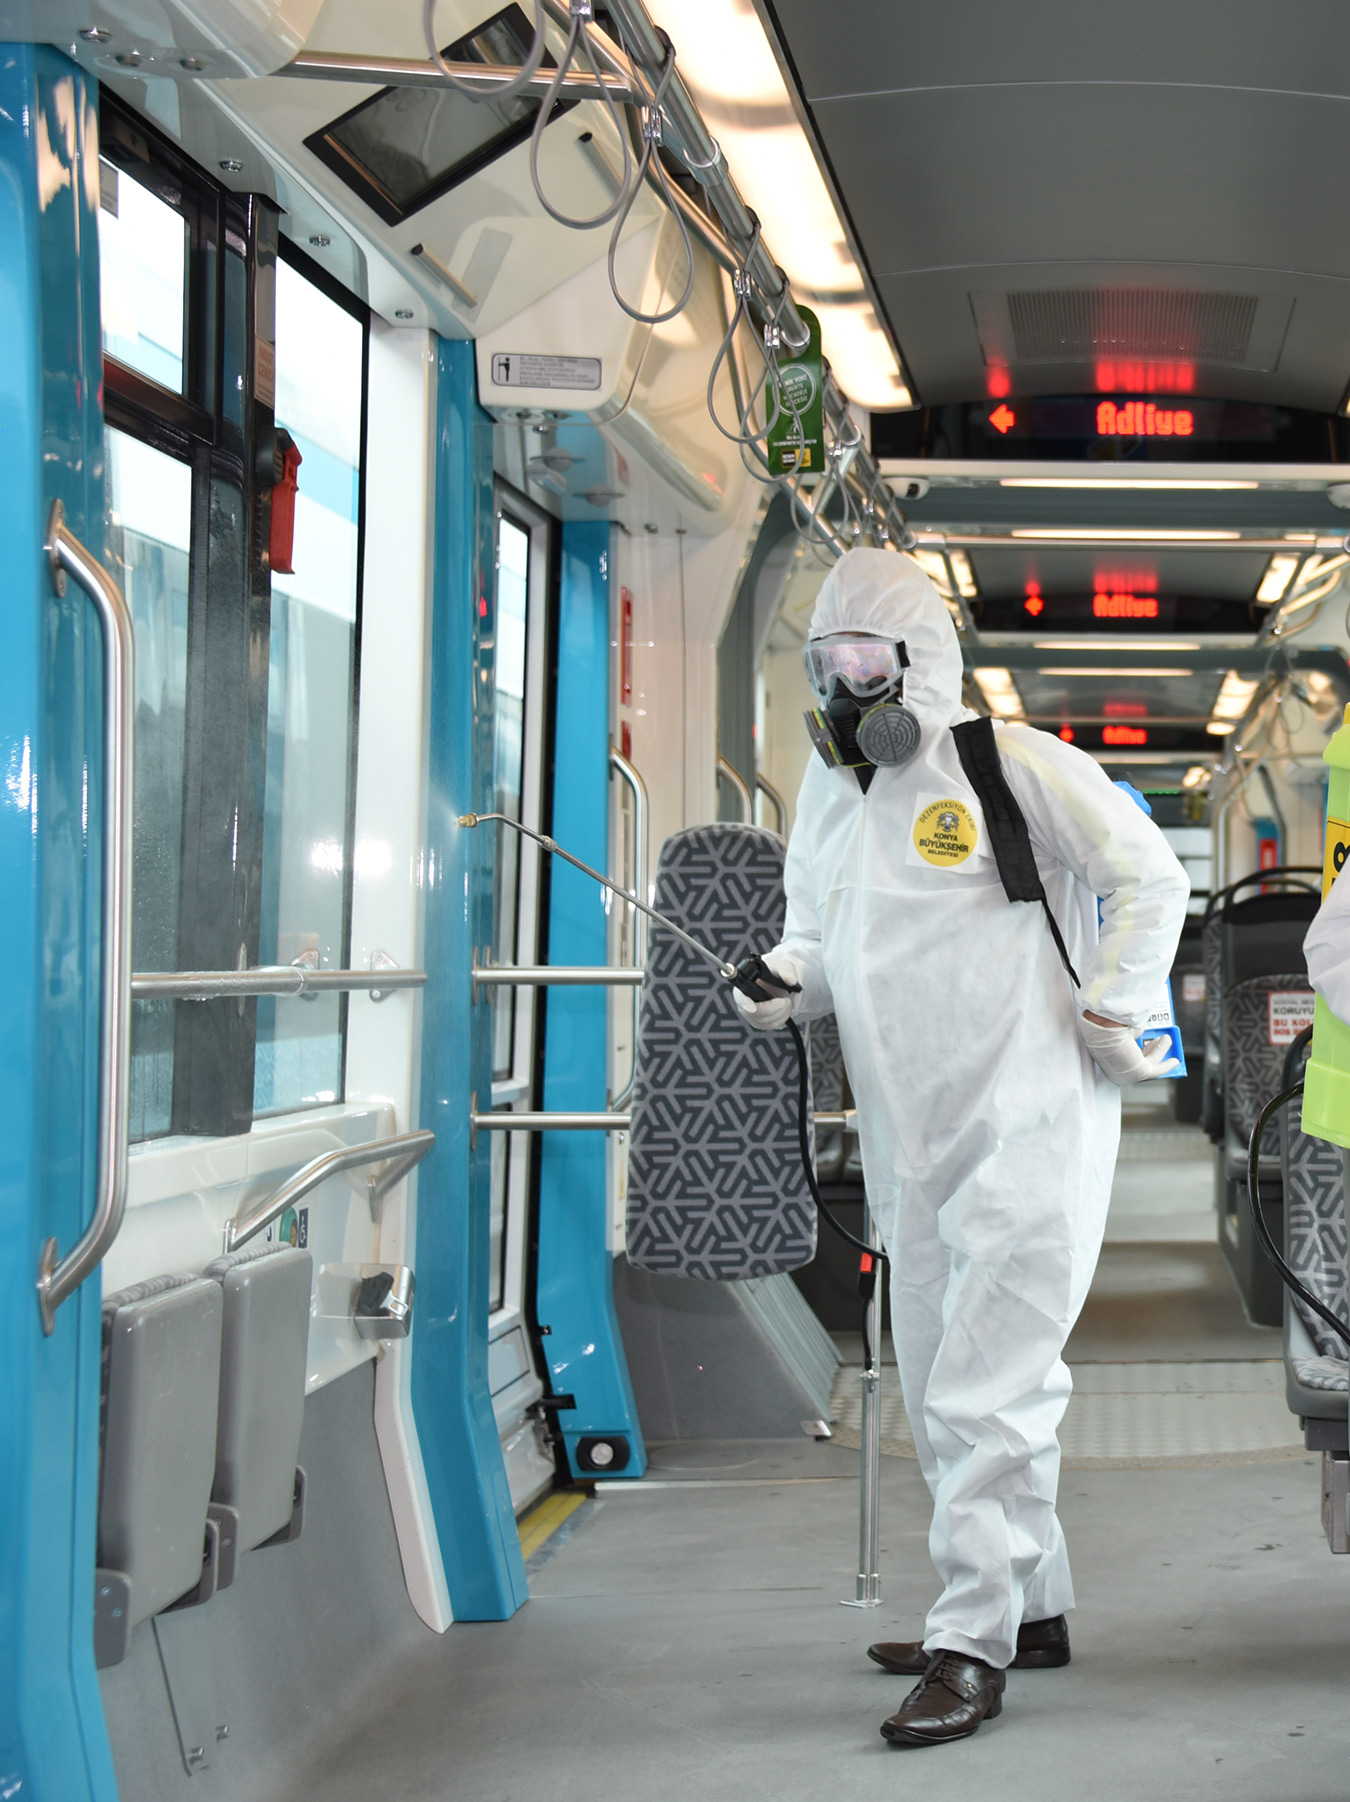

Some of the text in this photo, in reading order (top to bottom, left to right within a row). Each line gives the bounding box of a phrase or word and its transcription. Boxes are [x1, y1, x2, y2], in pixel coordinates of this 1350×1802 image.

[1096, 401, 1194, 436] Adliye
[919, 802, 967, 823] DEZENFEKSİYON
[919, 837, 970, 853] BÜYÜKŞEHİR
[934, 832, 958, 842] KONYA
